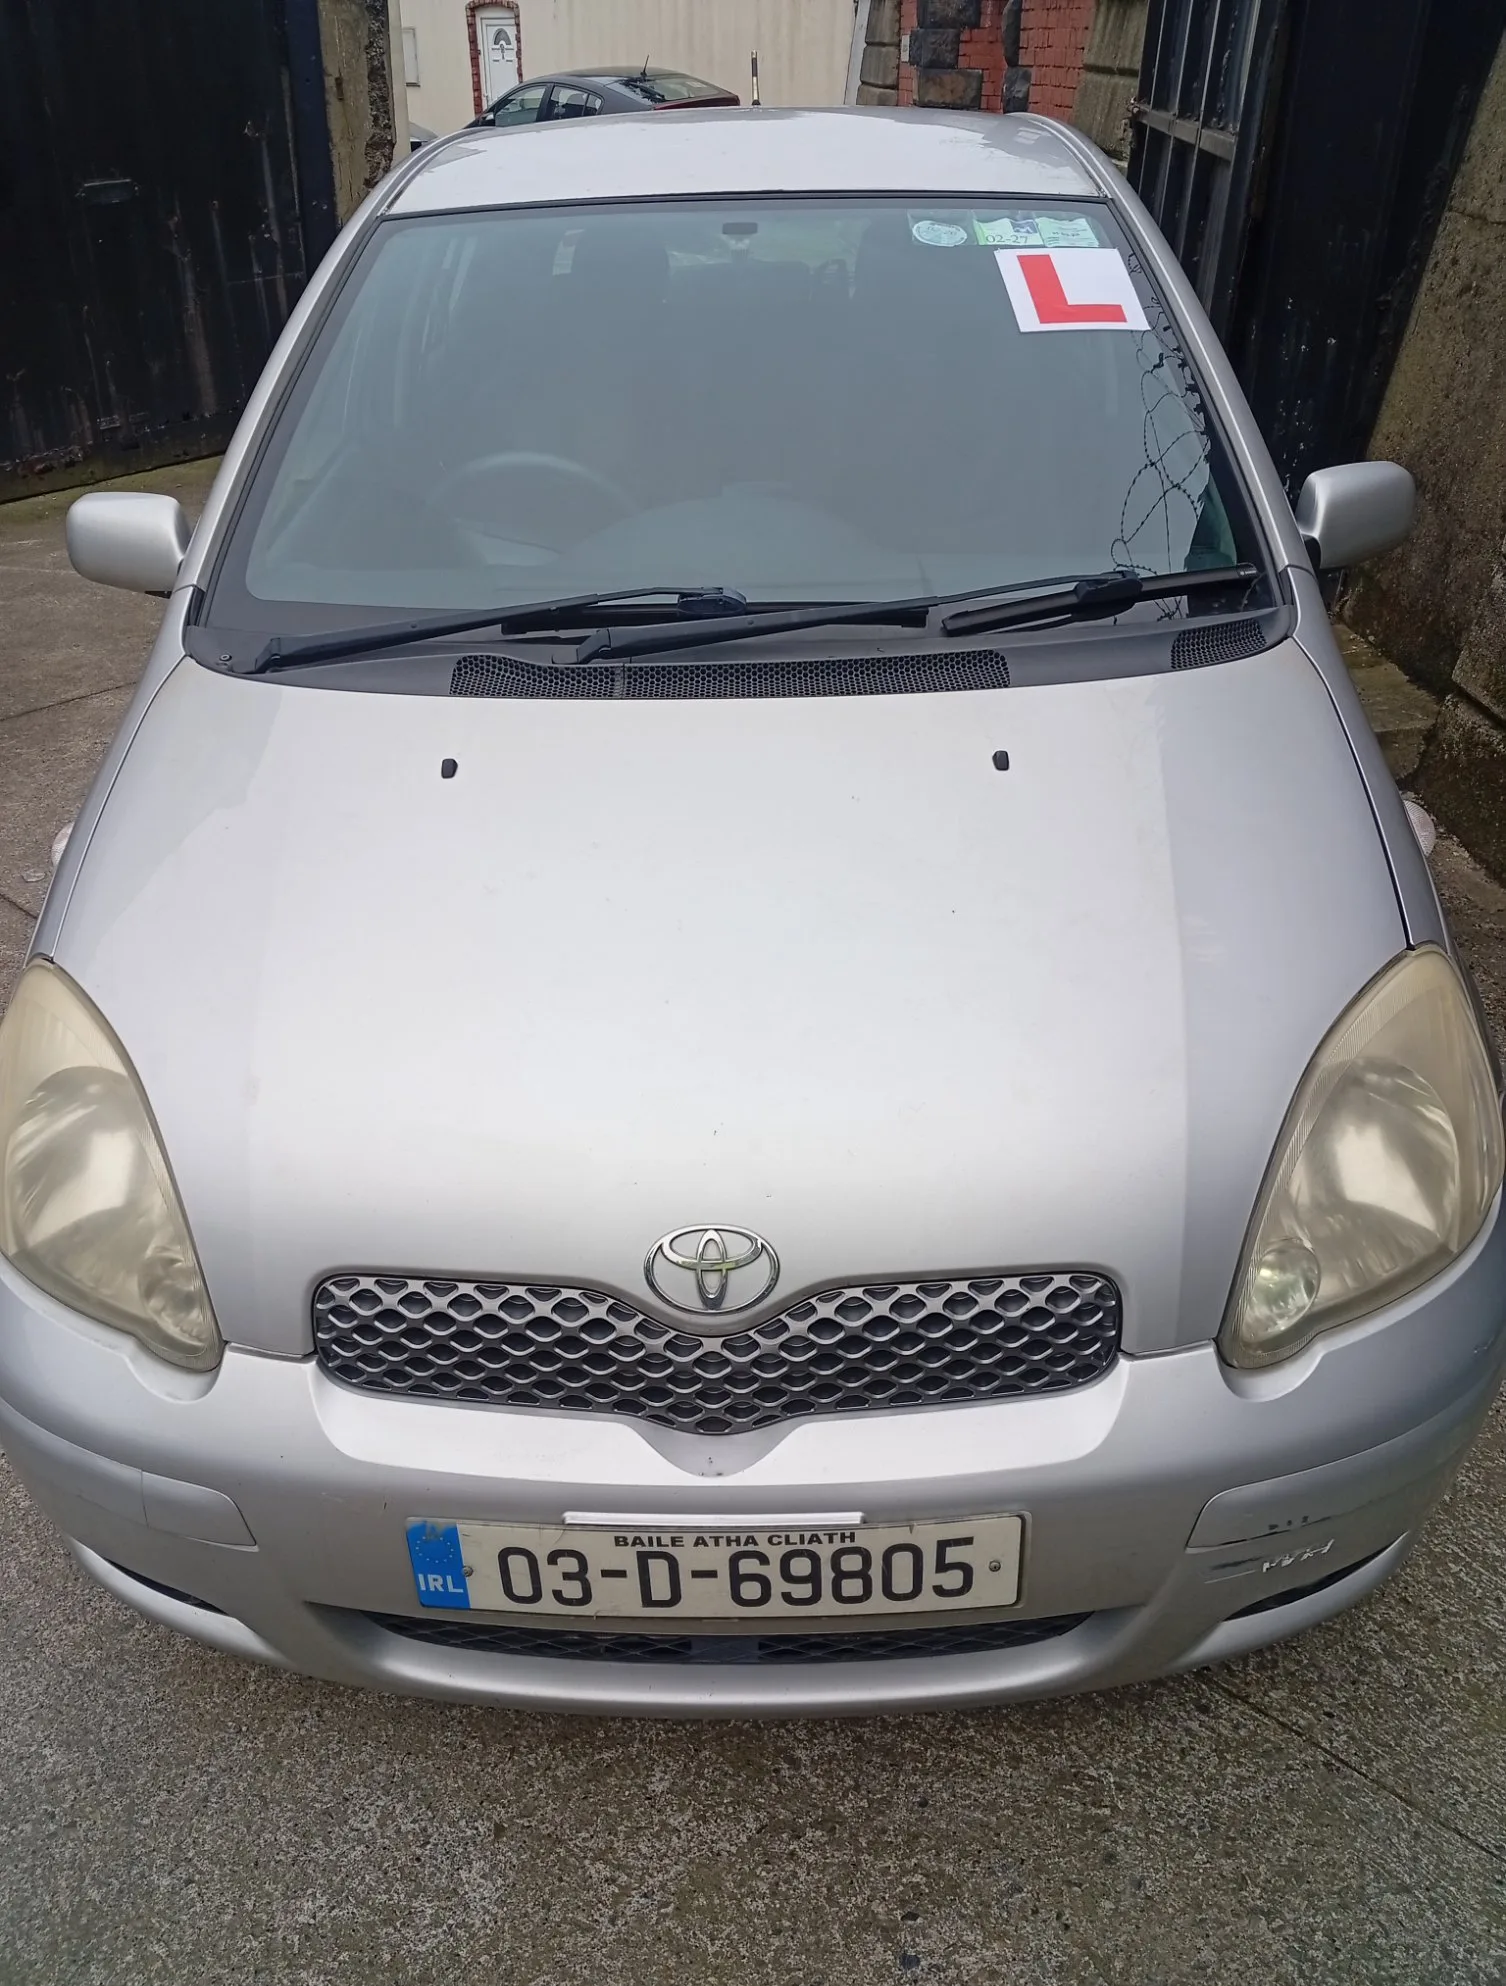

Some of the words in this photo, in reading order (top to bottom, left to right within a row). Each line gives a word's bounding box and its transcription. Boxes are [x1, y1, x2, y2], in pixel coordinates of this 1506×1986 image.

[985, 234, 1028, 244] 02-27
[1017, 254, 1128, 324] L
[613, 1535, 685, 1548] BAILE
[692, 1534, 759, 1547] ATHA
[767, 1531, 856, 1546] CLIATH
[417, 1572, 464, 1594] IRL
[497, 1536, 974, 1608] 03-D-69805
